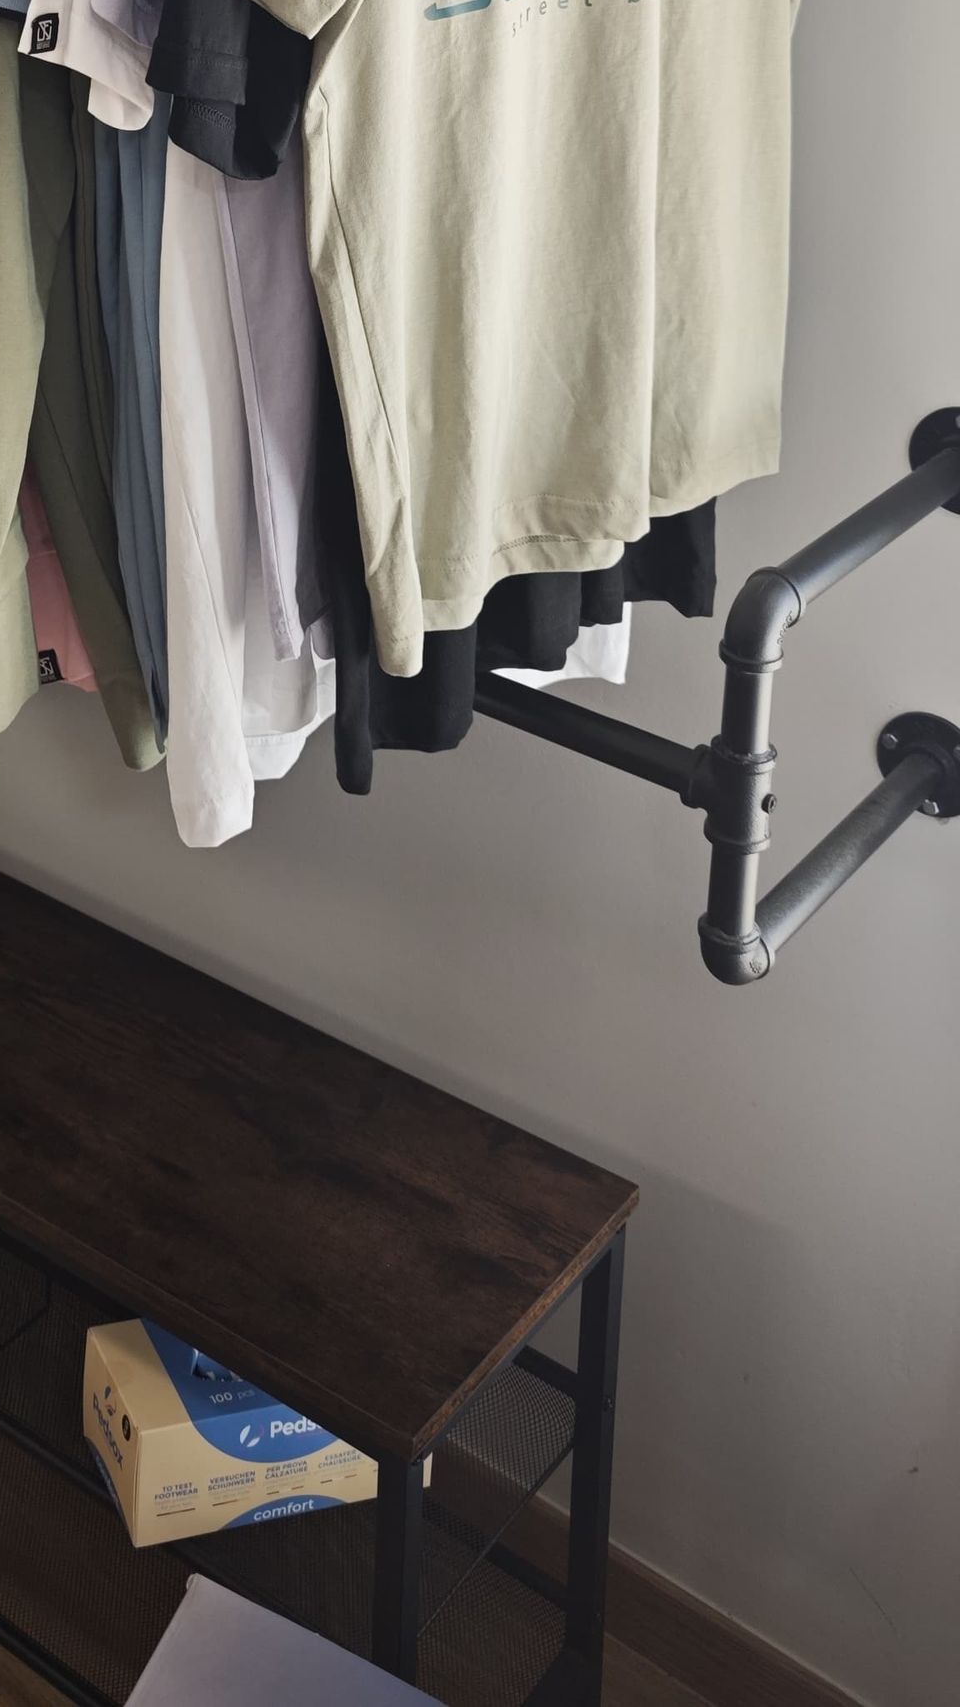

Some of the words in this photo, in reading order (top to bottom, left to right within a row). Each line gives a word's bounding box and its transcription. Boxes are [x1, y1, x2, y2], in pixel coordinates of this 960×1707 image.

[209, 1391, 233, 1405] 100
[270, 1415, 323, 1438] Peds
[175, 1482, 193, 1490] TEST
[154, 1488, 198, 1501] FOOTWEAR
[253, 1498, 315, 1521] comfort
